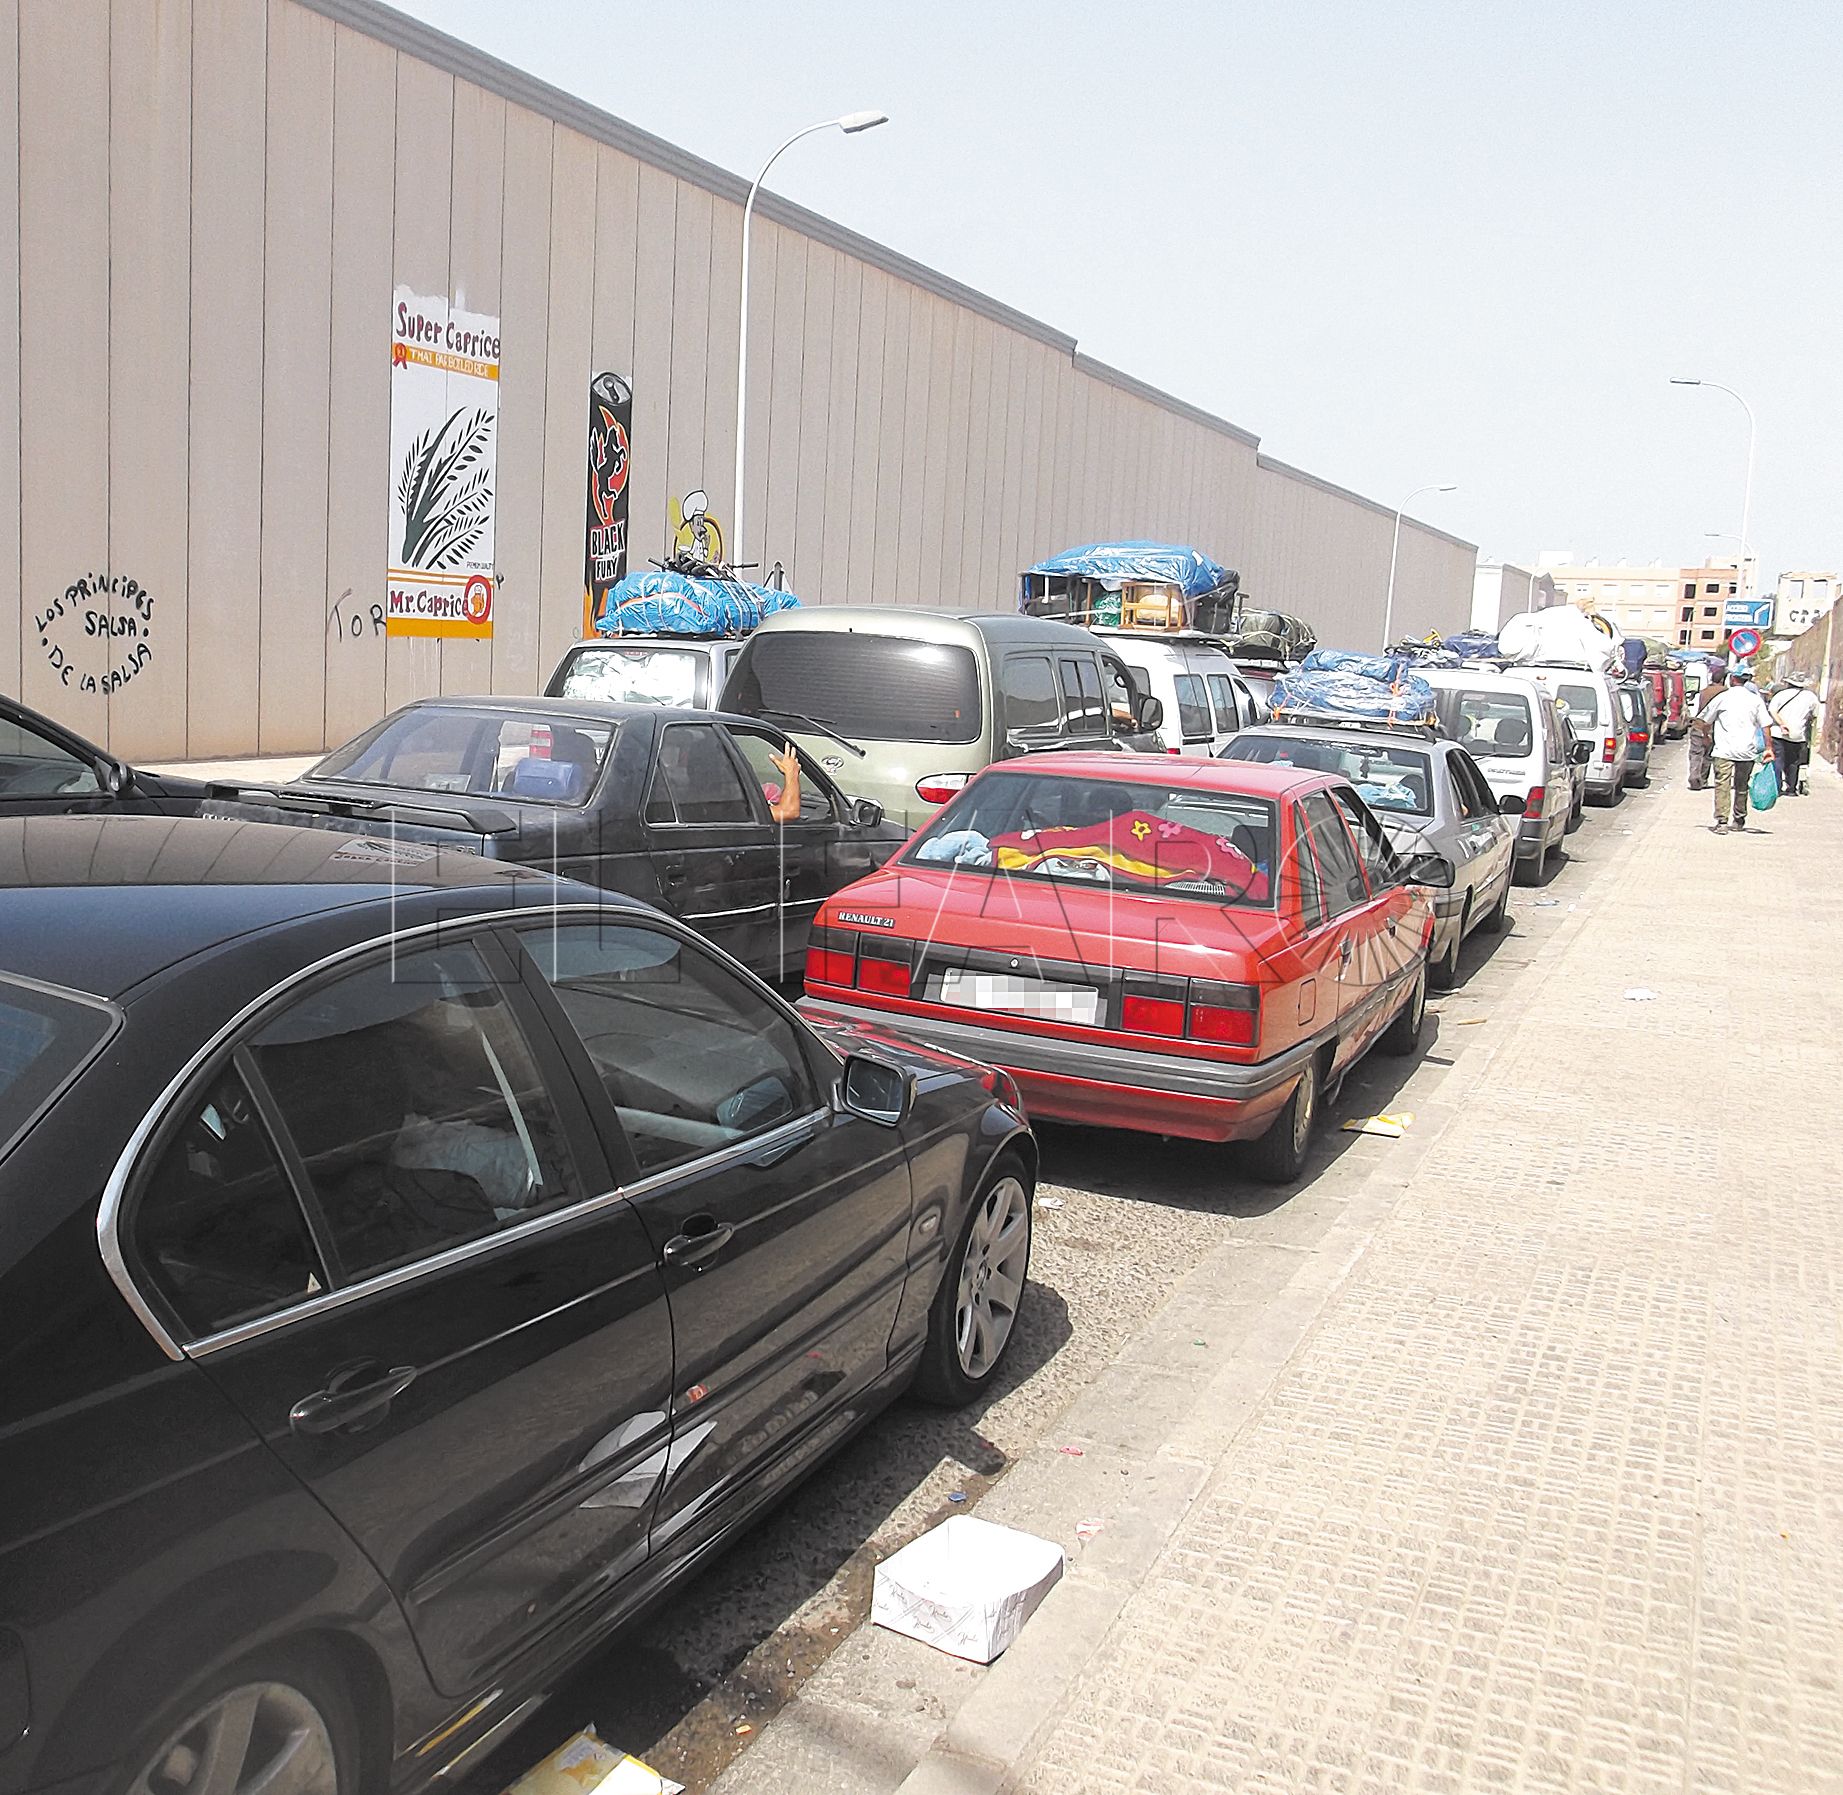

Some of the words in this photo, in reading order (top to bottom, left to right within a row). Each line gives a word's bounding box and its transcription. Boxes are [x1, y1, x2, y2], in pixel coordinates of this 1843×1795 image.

[396, 301, 442, 343] Super
[446, 321, 500, 358] Caprice
[592, 522, 625, 556] BLACK
[596, 557, 618, 579] FURY
[35, 598, 64, 633] LOS
[85, 610, 137, 639] SALSA
[48, 645, 74, 686] DE
[80, 673, 96, 693] LA
[101, 643, 152, 694] SALSA
[839, 911, 882, 925] RENAULT
[883, 918, 894, 927] 21
